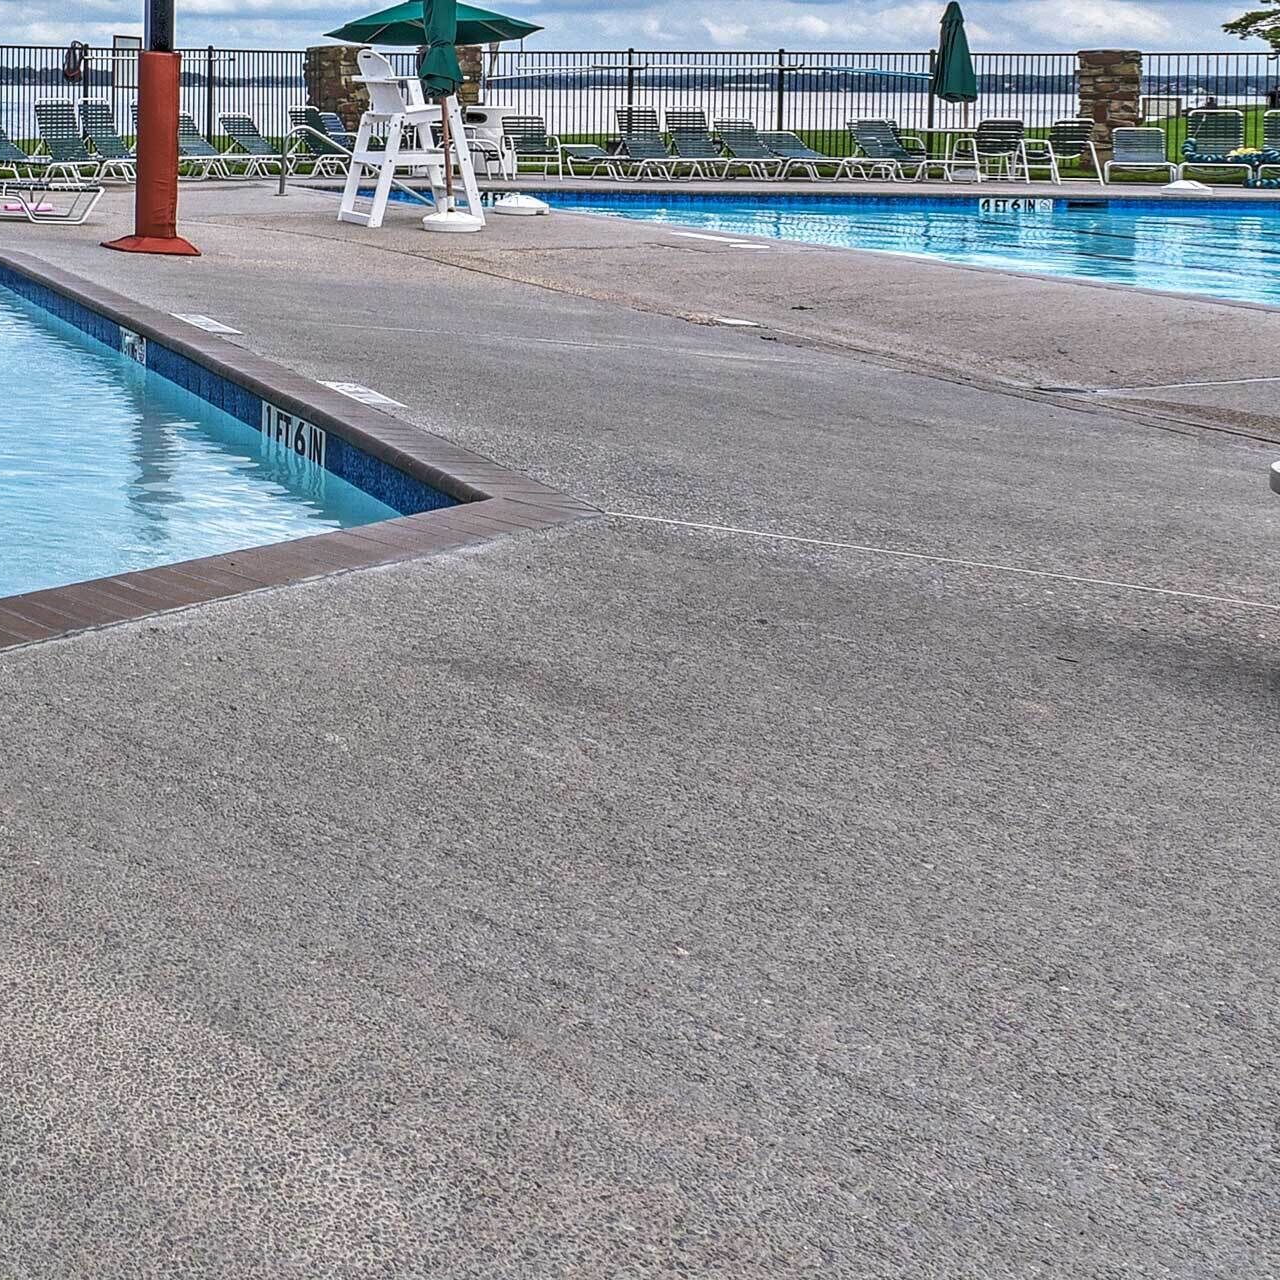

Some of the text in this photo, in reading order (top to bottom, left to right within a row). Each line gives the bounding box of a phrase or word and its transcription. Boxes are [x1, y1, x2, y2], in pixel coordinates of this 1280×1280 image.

[981, 199, 1036, 213] 4 FT 6 IN
[265, 404, 323, 468] 1 FT 6 IN
